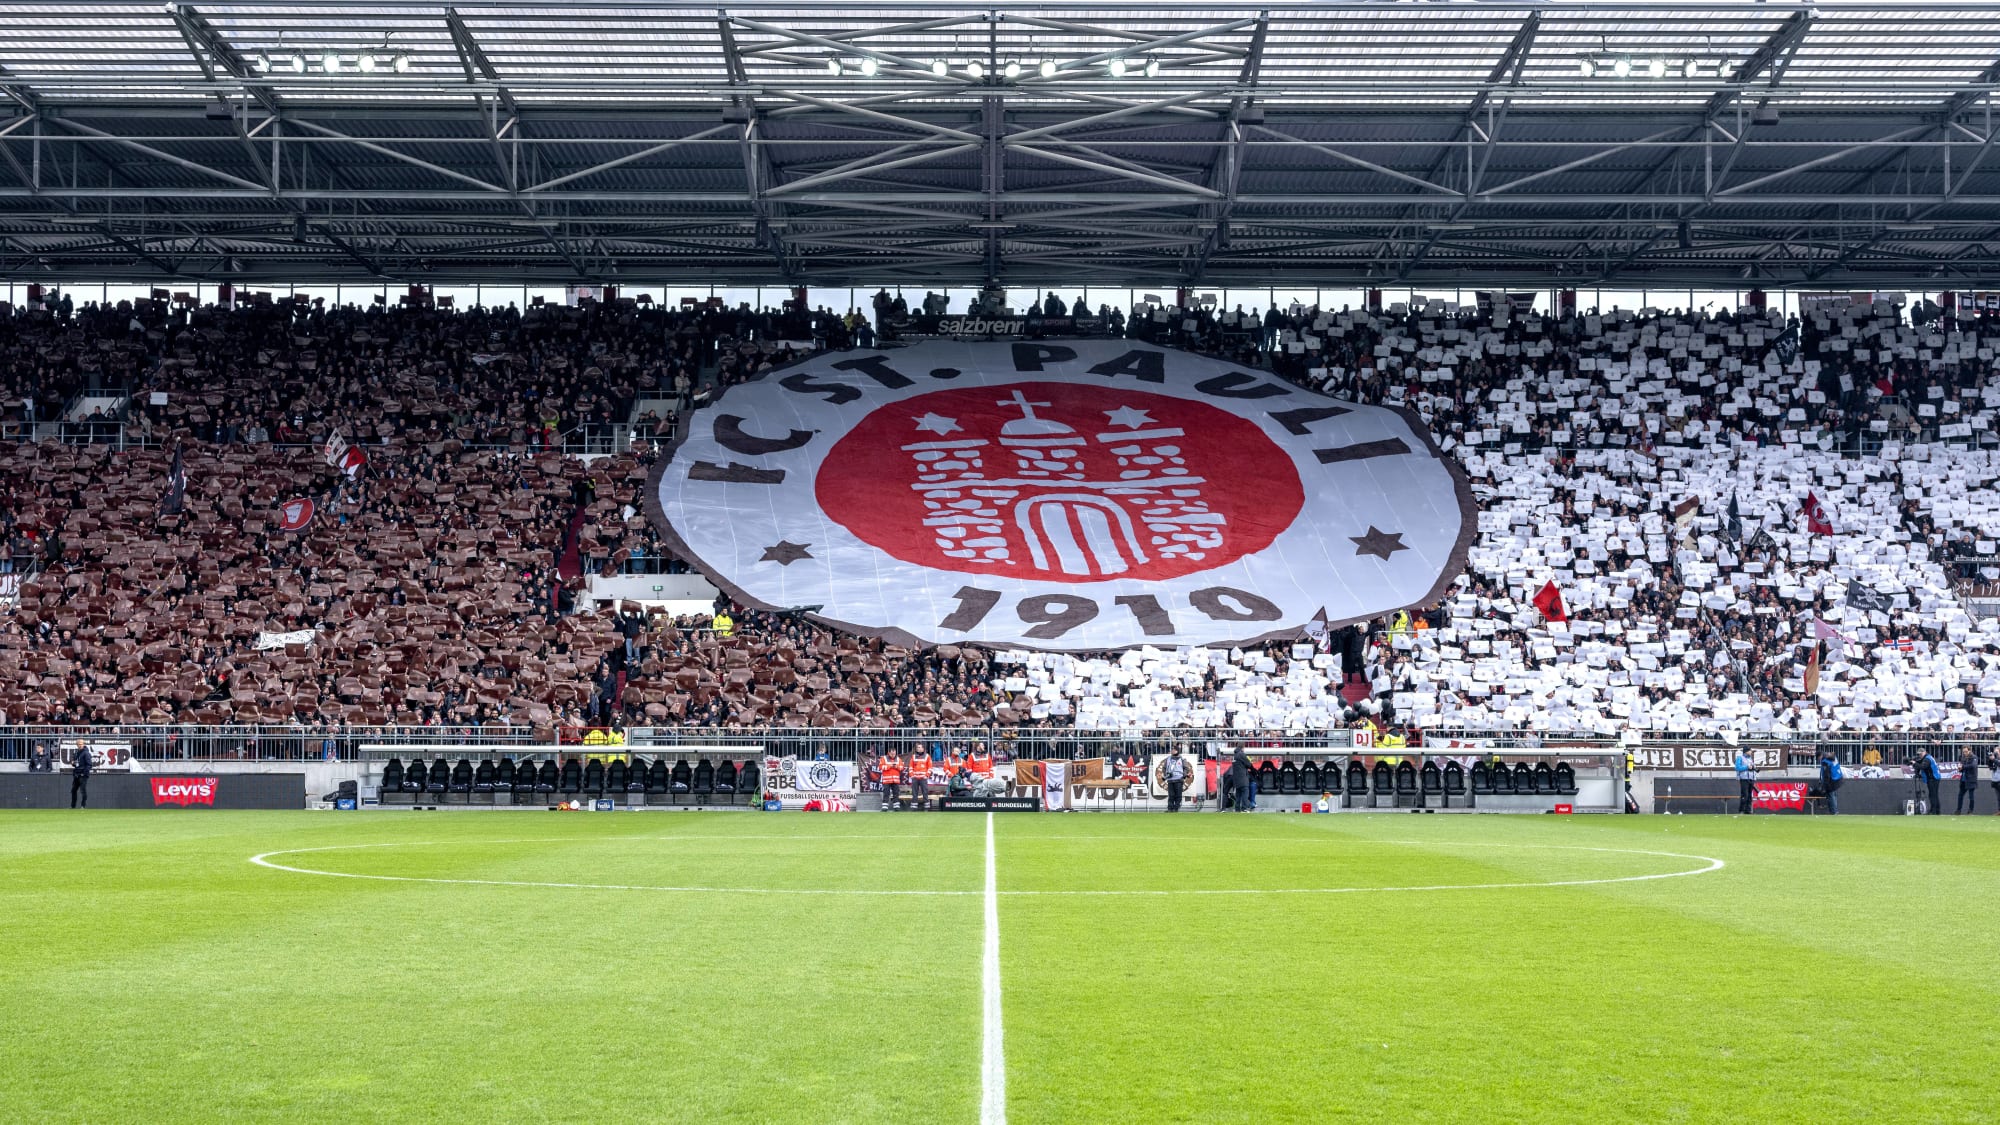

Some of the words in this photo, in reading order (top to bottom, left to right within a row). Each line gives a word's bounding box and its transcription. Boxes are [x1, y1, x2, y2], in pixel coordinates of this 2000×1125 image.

[688, 412, 814, 485] FC
[1011, 342, 1412, 464] PAULI
[938, 585, 1284, 640] 1910
